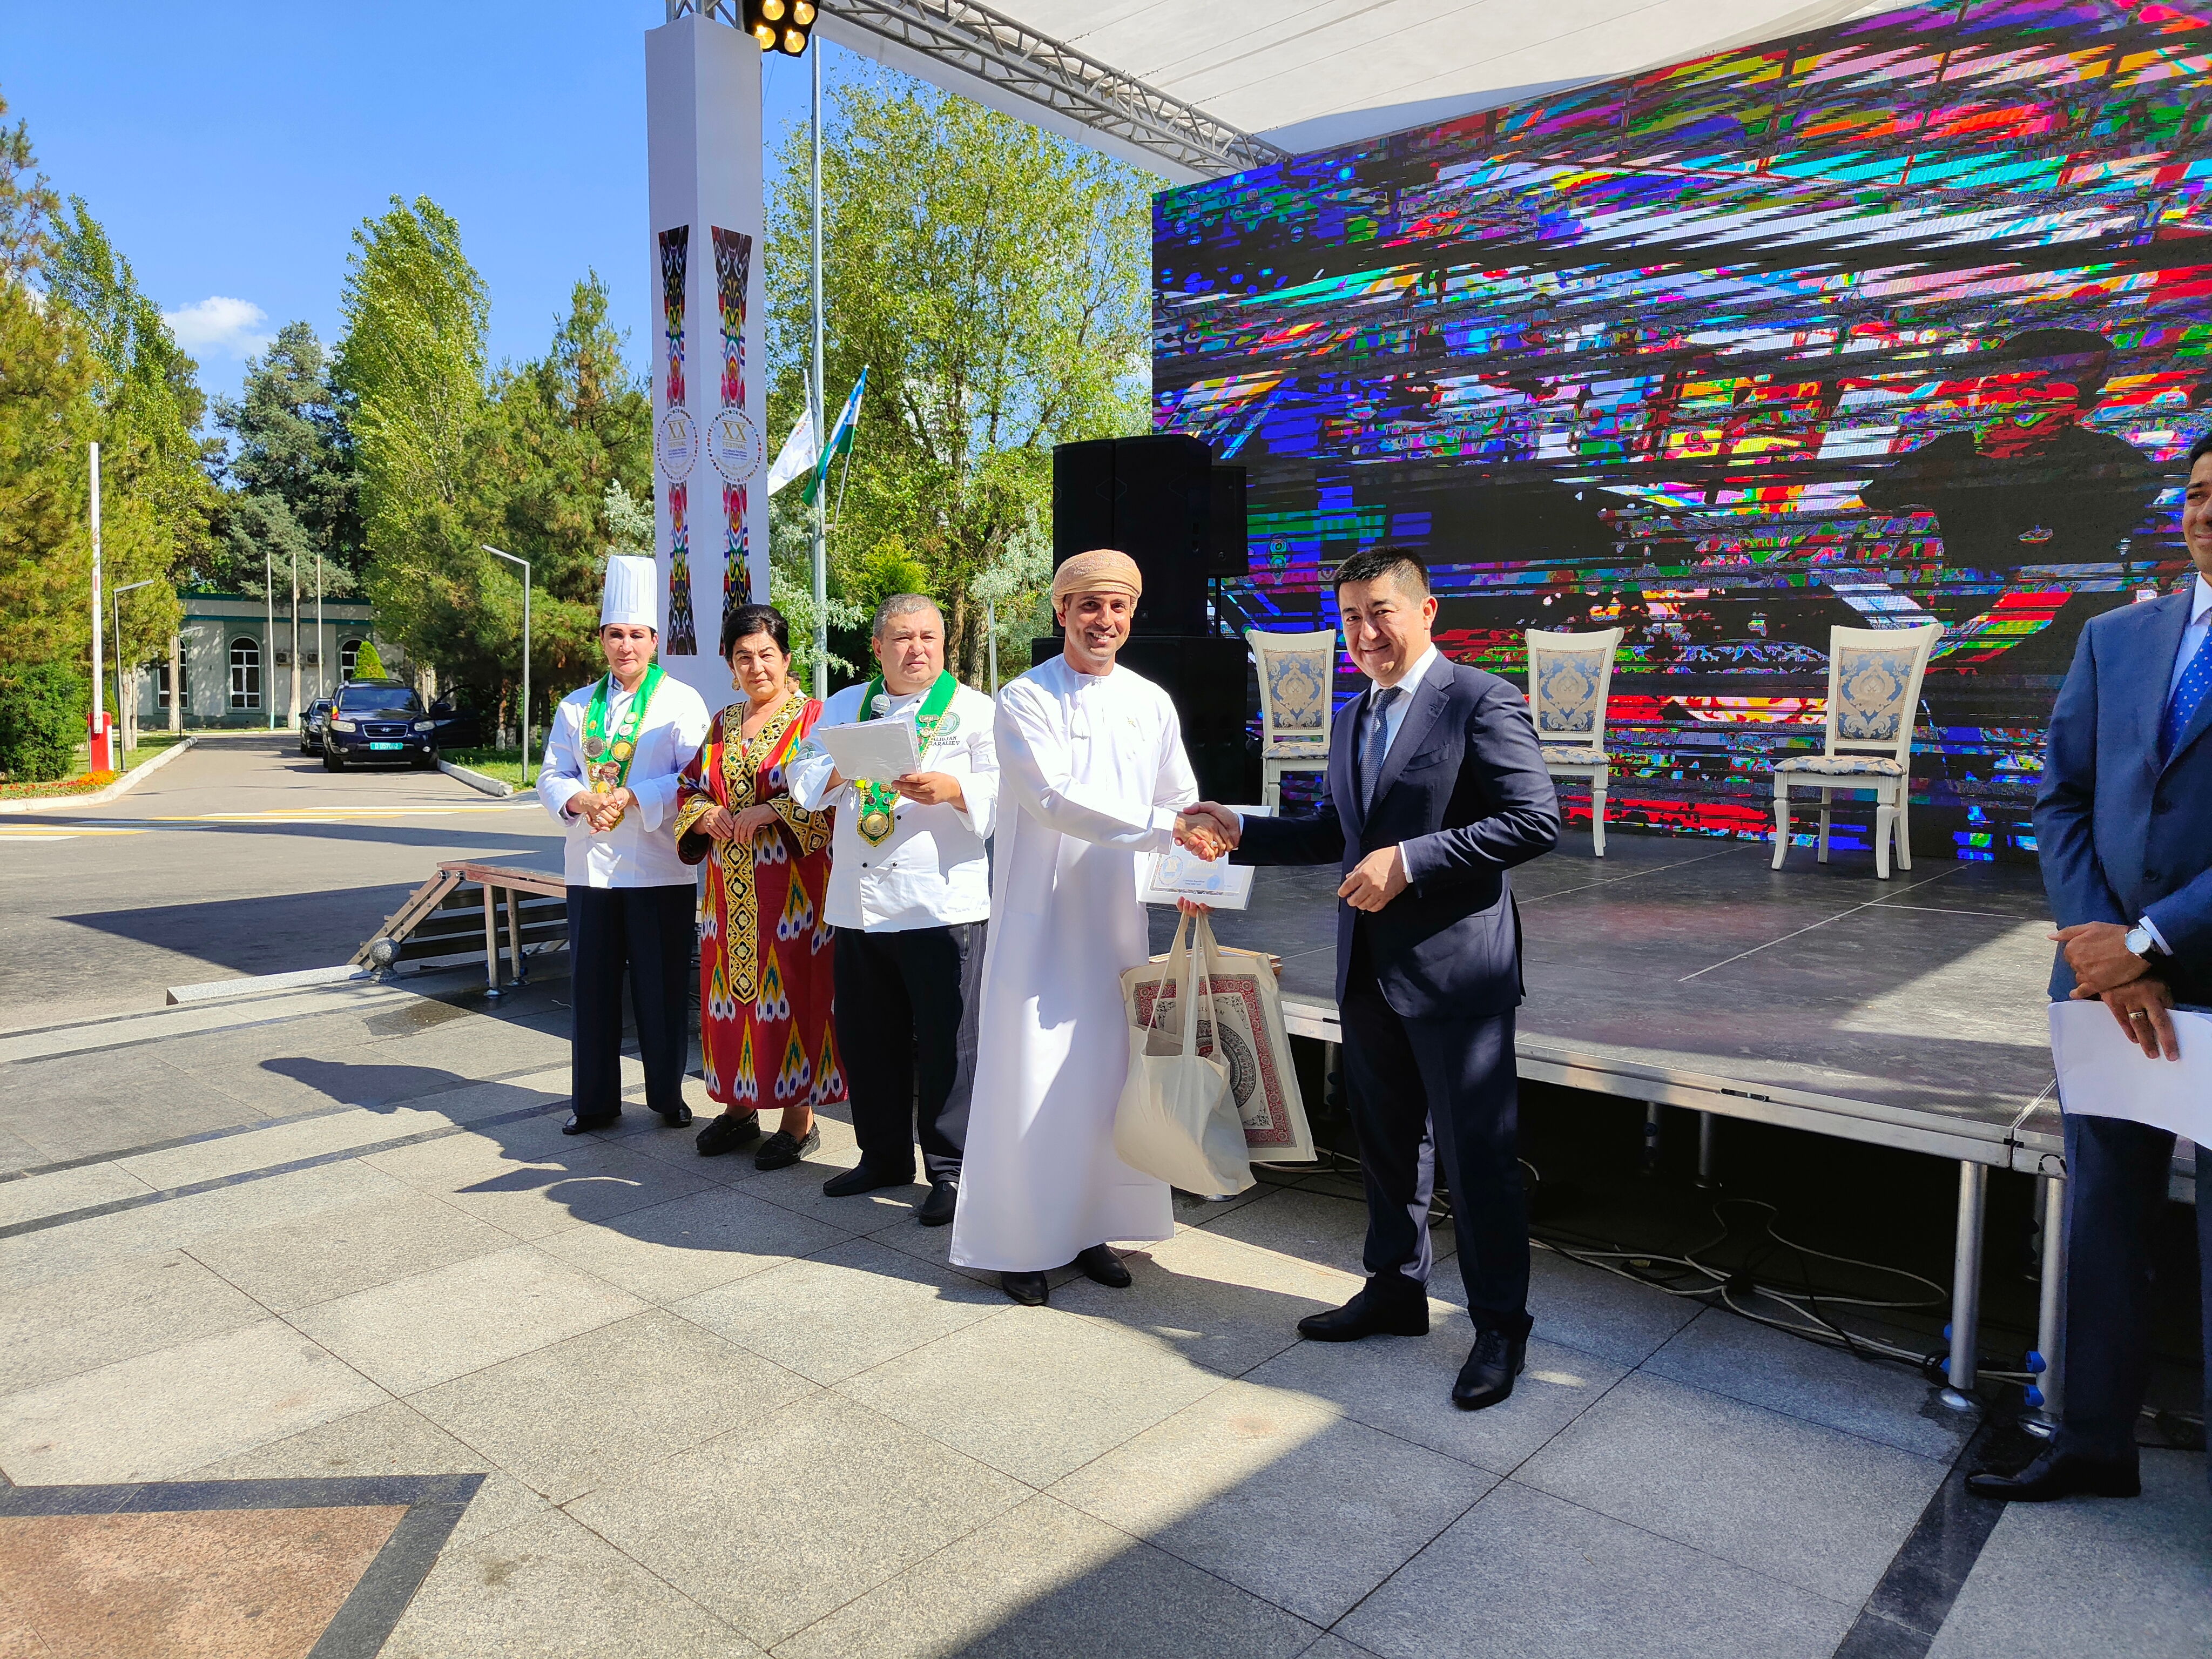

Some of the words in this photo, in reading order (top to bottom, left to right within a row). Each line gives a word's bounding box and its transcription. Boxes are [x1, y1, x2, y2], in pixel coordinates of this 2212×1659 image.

[667, 421, 686, 439] XX
[722, 422, 747, 441] XX
[1187, 860, 1219, 869] Diplom
